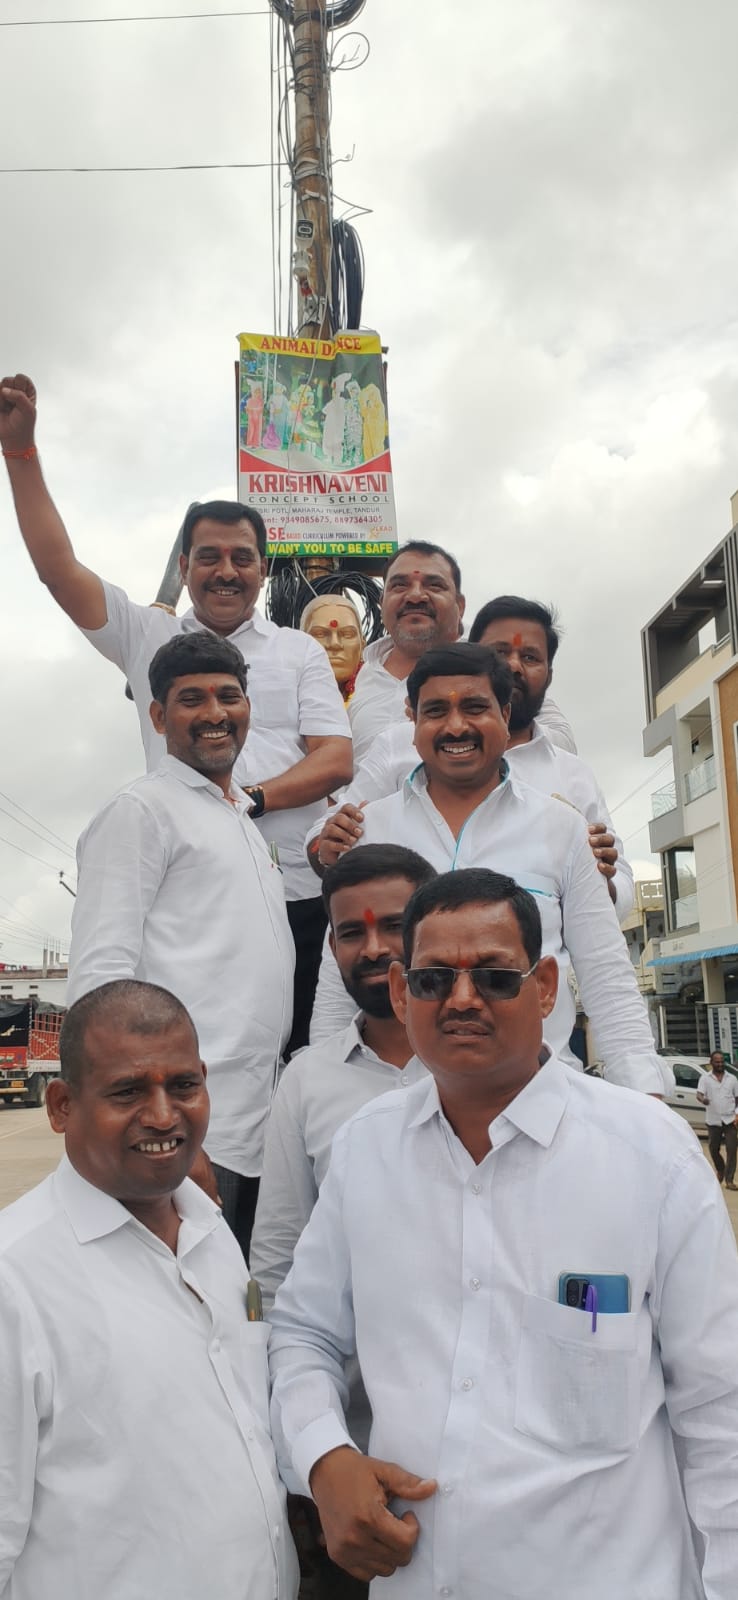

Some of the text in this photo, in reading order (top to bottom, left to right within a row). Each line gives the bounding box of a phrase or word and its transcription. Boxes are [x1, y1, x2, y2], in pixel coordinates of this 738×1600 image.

[248, 474, 388, 494] KRISHNAVENI
[248, 496, 389, 504] CONCEPT SCHOOL
[268, 543, 393, 554] WANT YOU TO BE SAFE
